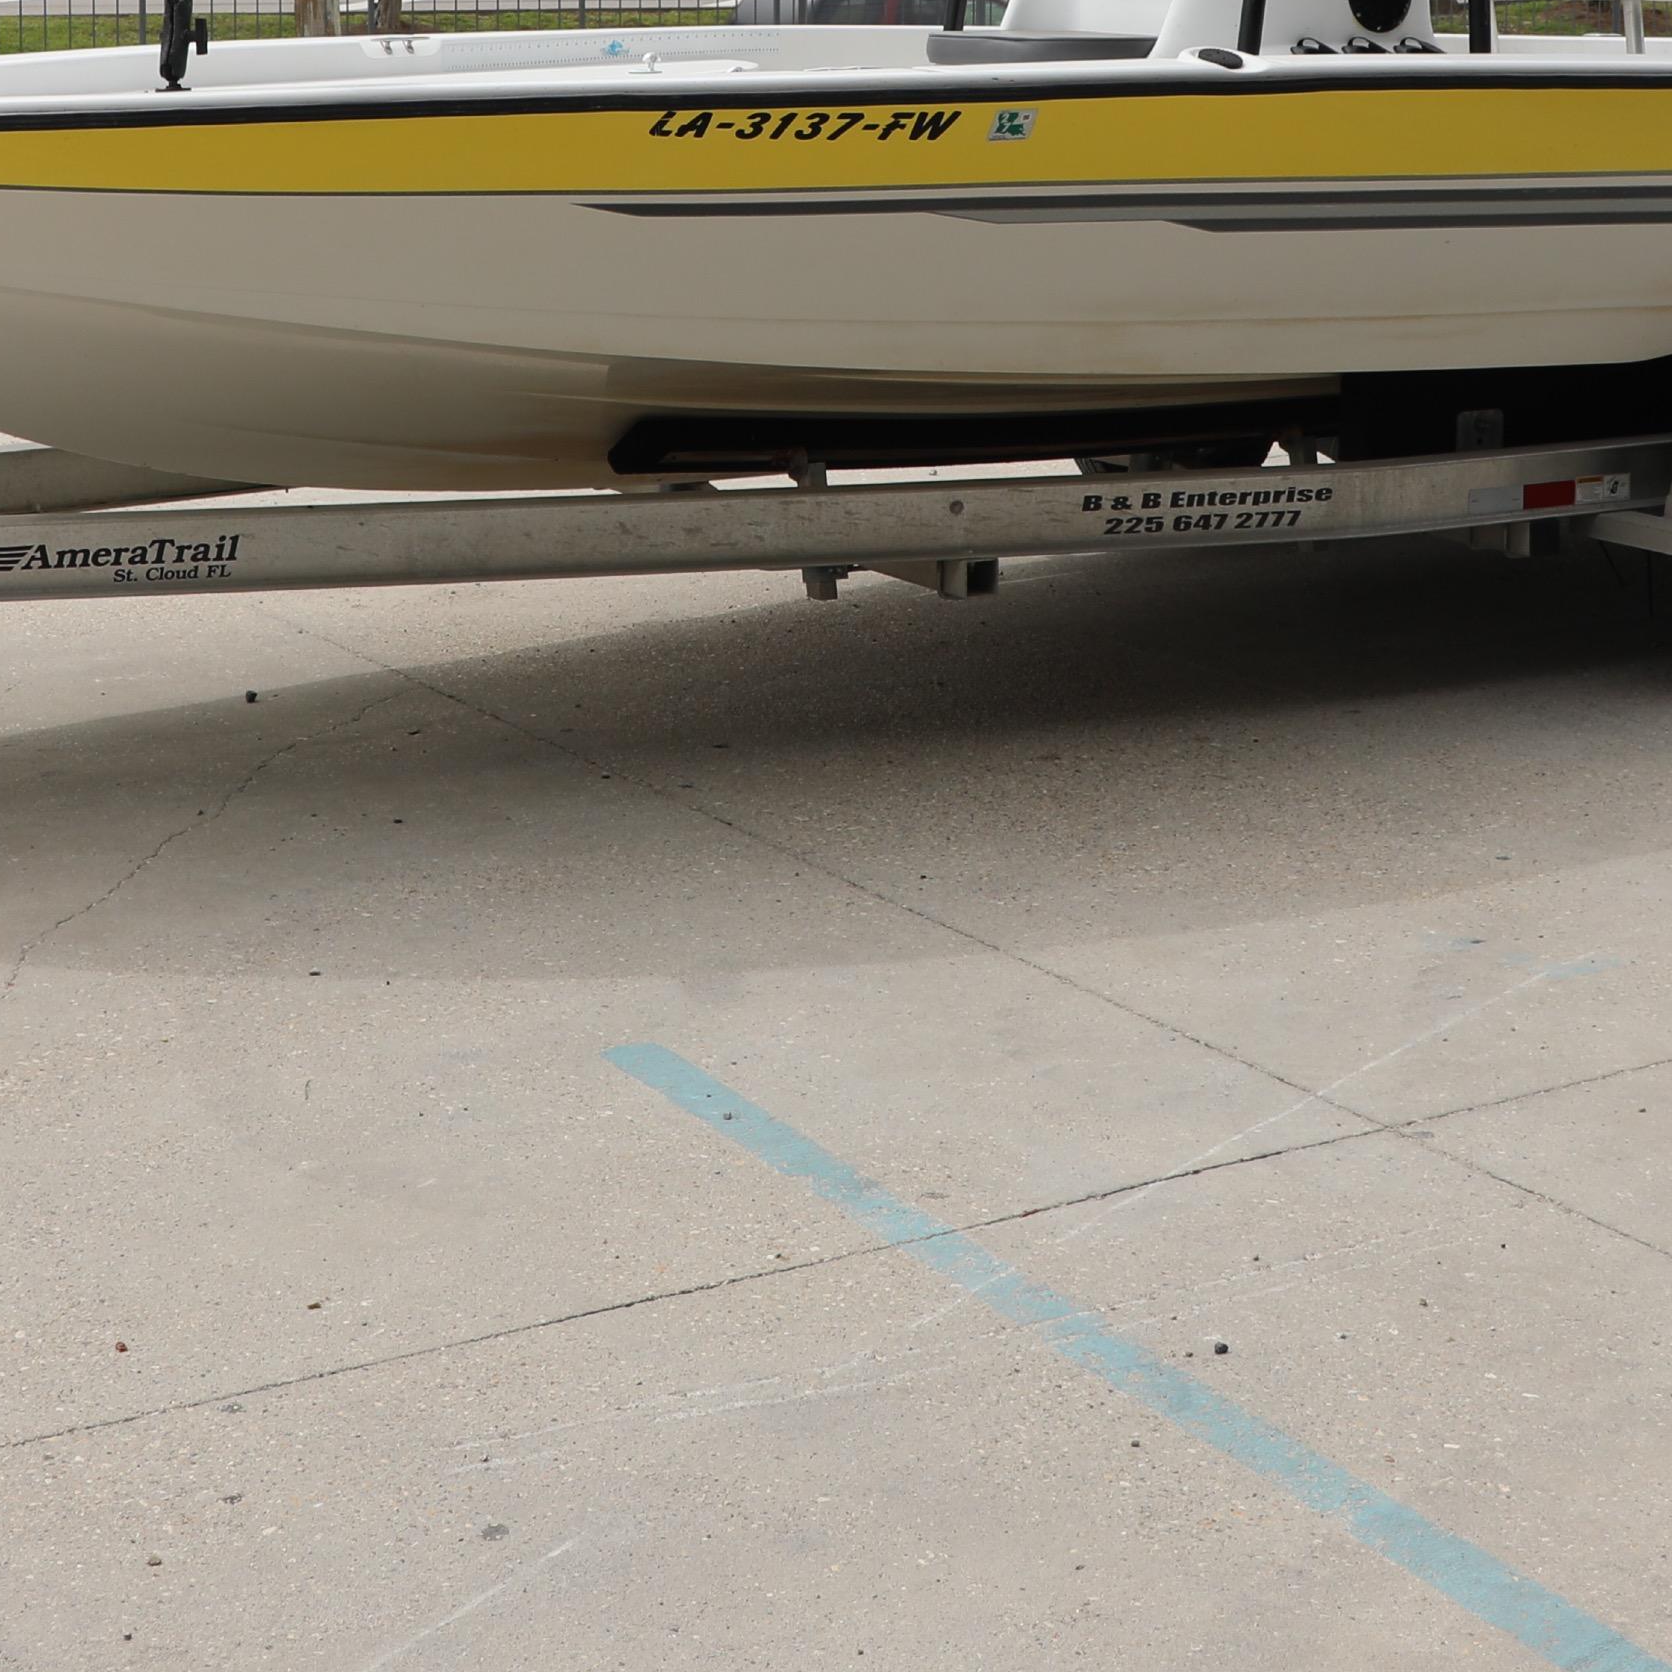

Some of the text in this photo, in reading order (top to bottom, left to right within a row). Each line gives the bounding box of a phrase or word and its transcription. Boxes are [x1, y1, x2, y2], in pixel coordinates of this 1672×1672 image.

[648, 110, 962, 141] LA-3137-FW
[1082, 485, 1333, 512] B & B Enterprise
[1104, 510, 1302, 535] 225 647 2777
[20, 534, 240, 570] AmeraTrail
[113, 564, 232, 583] St. Cloud FL
